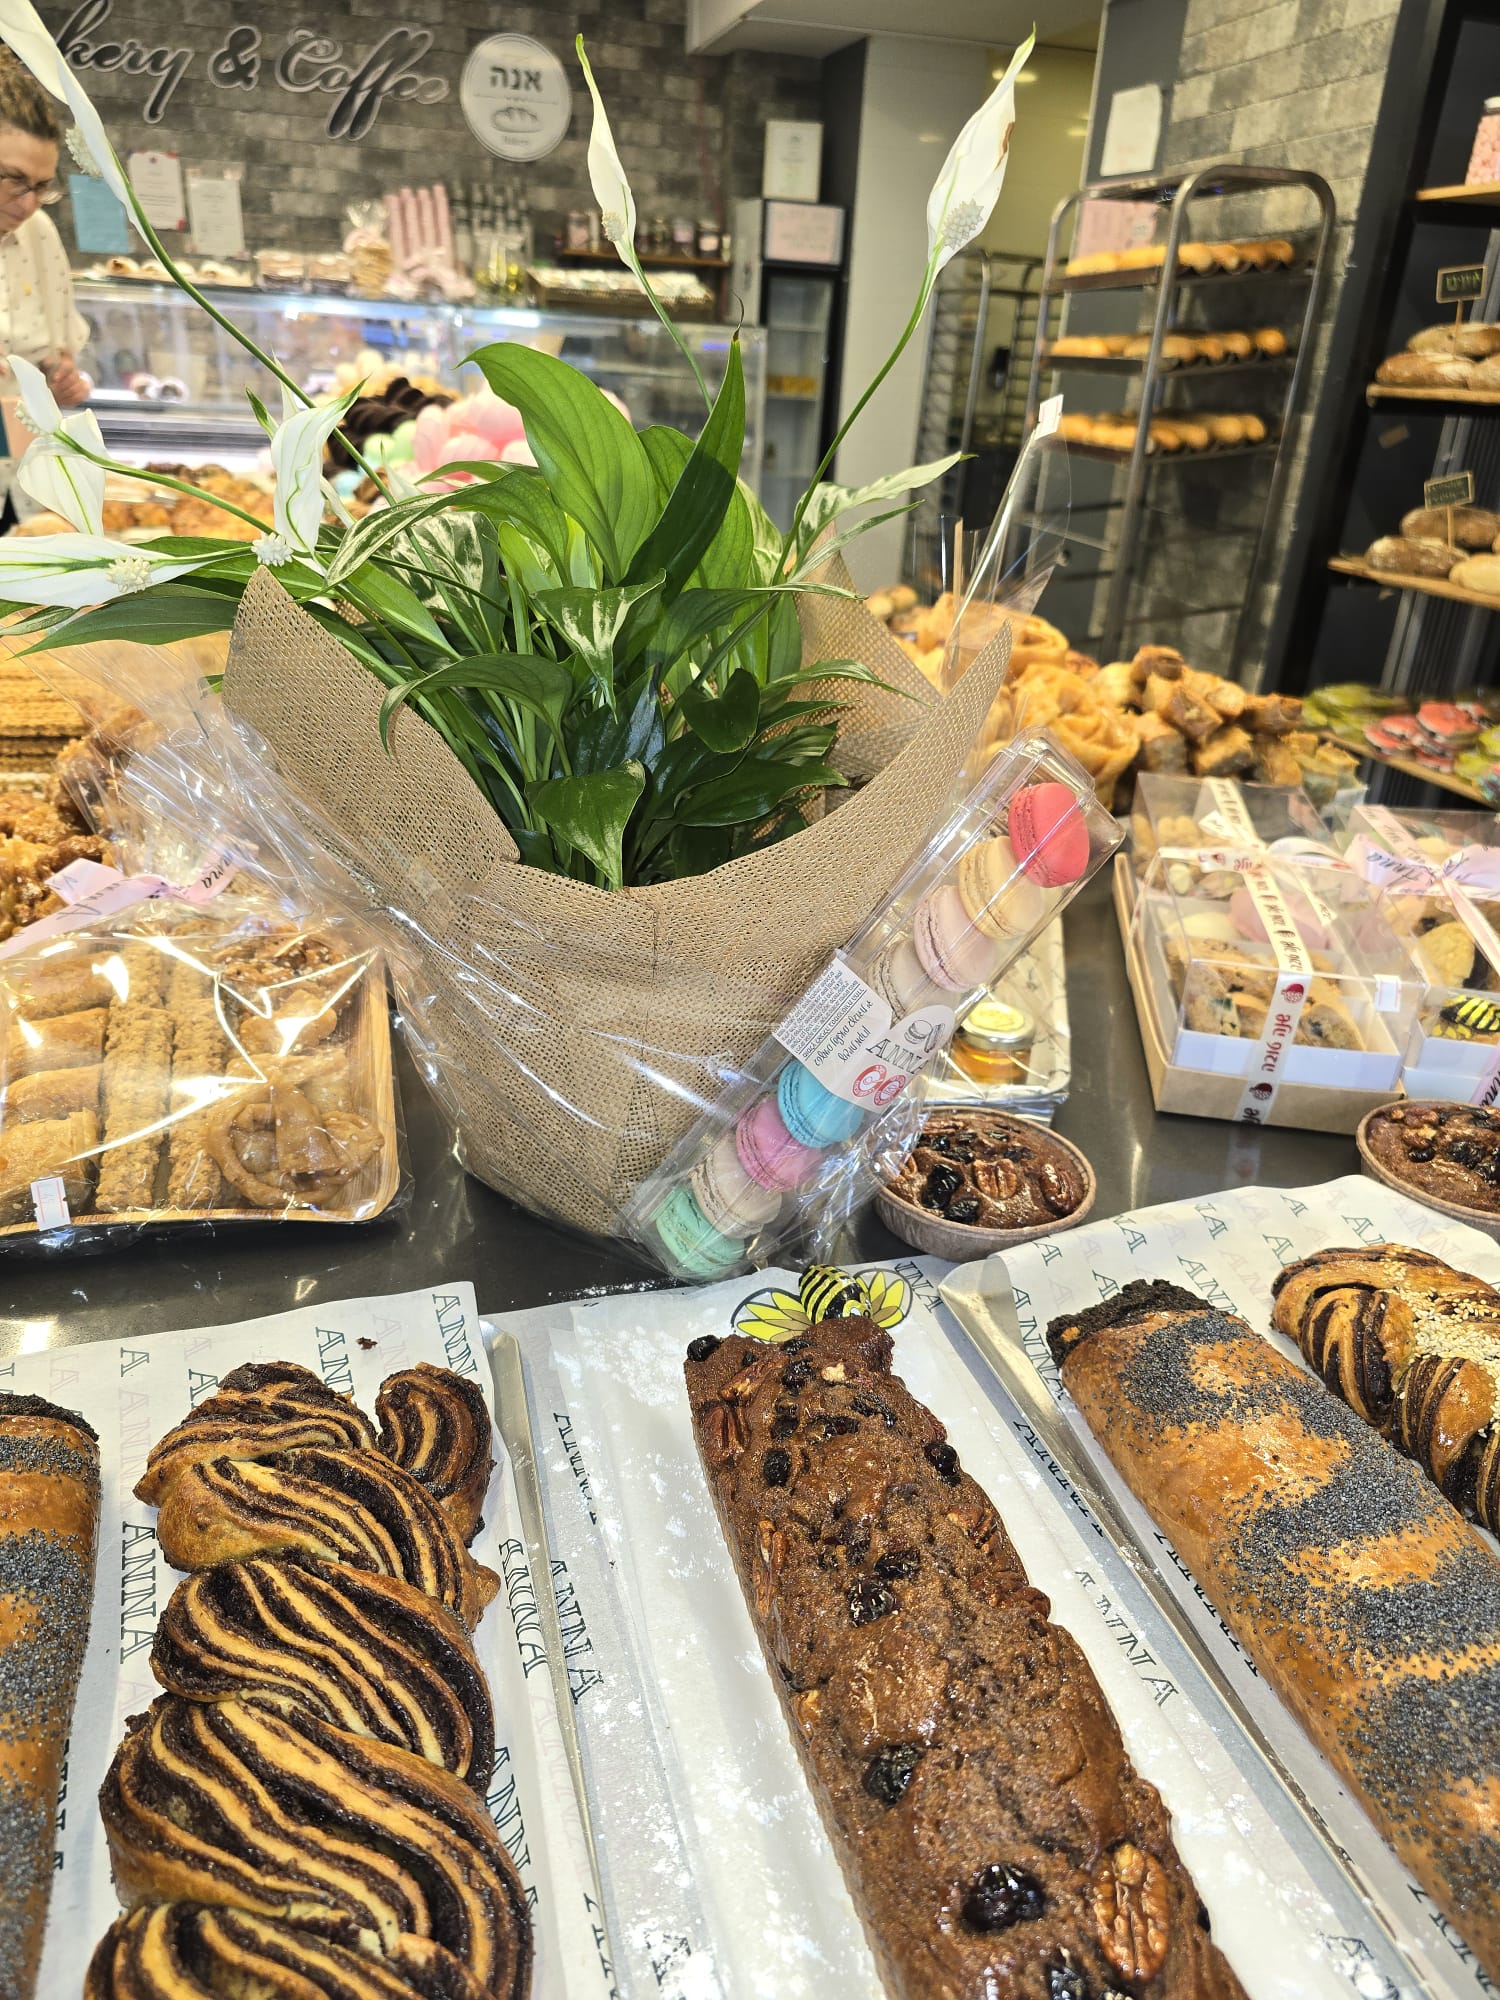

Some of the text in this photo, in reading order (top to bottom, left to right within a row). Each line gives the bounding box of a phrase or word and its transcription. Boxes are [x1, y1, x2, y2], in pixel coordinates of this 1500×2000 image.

[207, 25, 261, 91] &
[275, 25, 450, 142] Coffee
[489, 66, 542, 92] אנה
[800, 1041, 816, 1057] מומלץ
[813, 1025, 830, 1043] לאכילה
[811, 1041, 835, 1066] בטעמים
[828, 1023, 852, 1048] נפלאים
[836, 1025, 871, 1063] עוגיות מקרון
[1261, 1013, 1292, 1074] שנה טובה
[1242, 1107, 1261, 1125] שנ
[315, 1326, 356, 1397] AN
[432, 1293, 486, 1395] ANN
[121, 1521, 157, 1664] ANNA
[499, 1539, 548, 1680] ANNA
